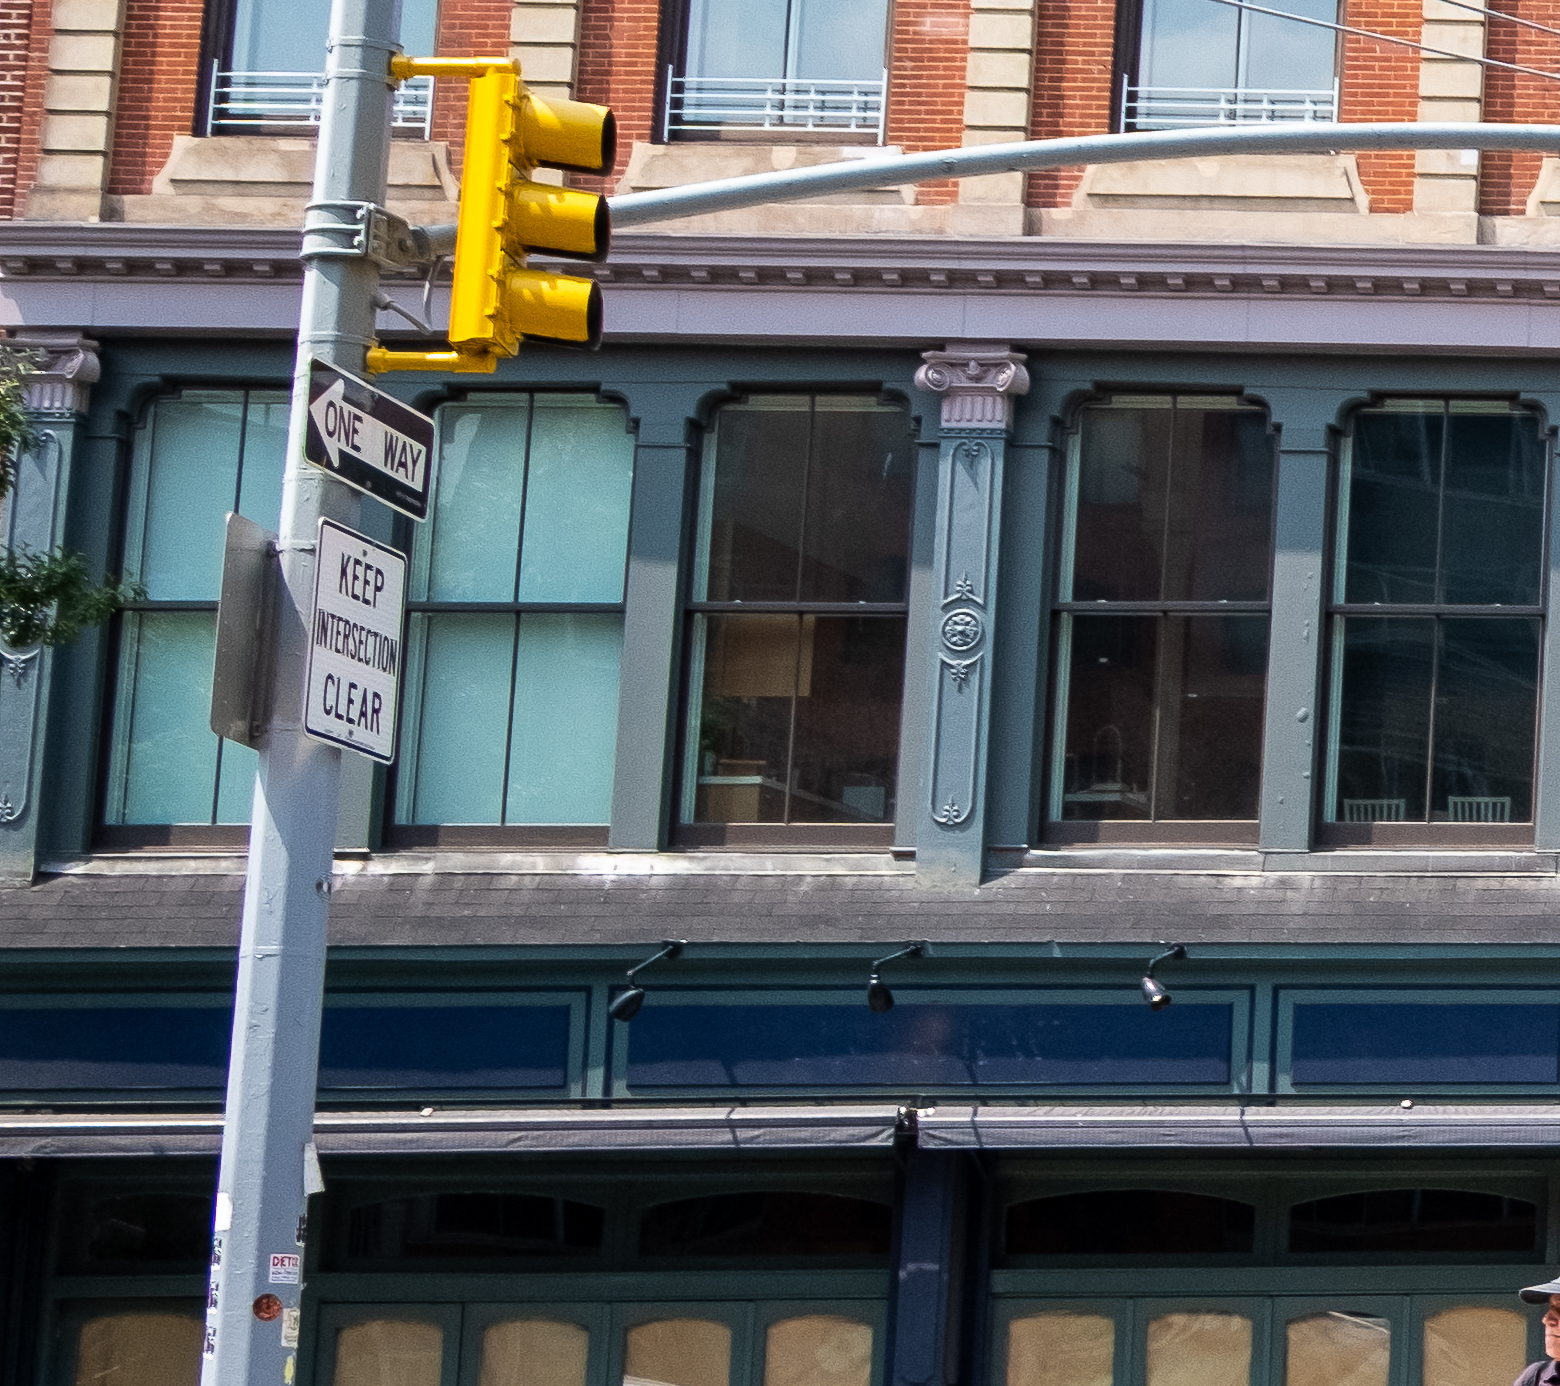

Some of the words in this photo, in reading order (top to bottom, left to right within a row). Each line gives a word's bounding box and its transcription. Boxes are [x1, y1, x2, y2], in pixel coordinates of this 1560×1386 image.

[325, 400, 363, 453] ONE
[384, 430, 422, 482] WAY
[339, 551, 385, 608] KEEP
[316, 608, 398, 677] INTERSECTION
[323, 673, 383, 735] CLEAR
